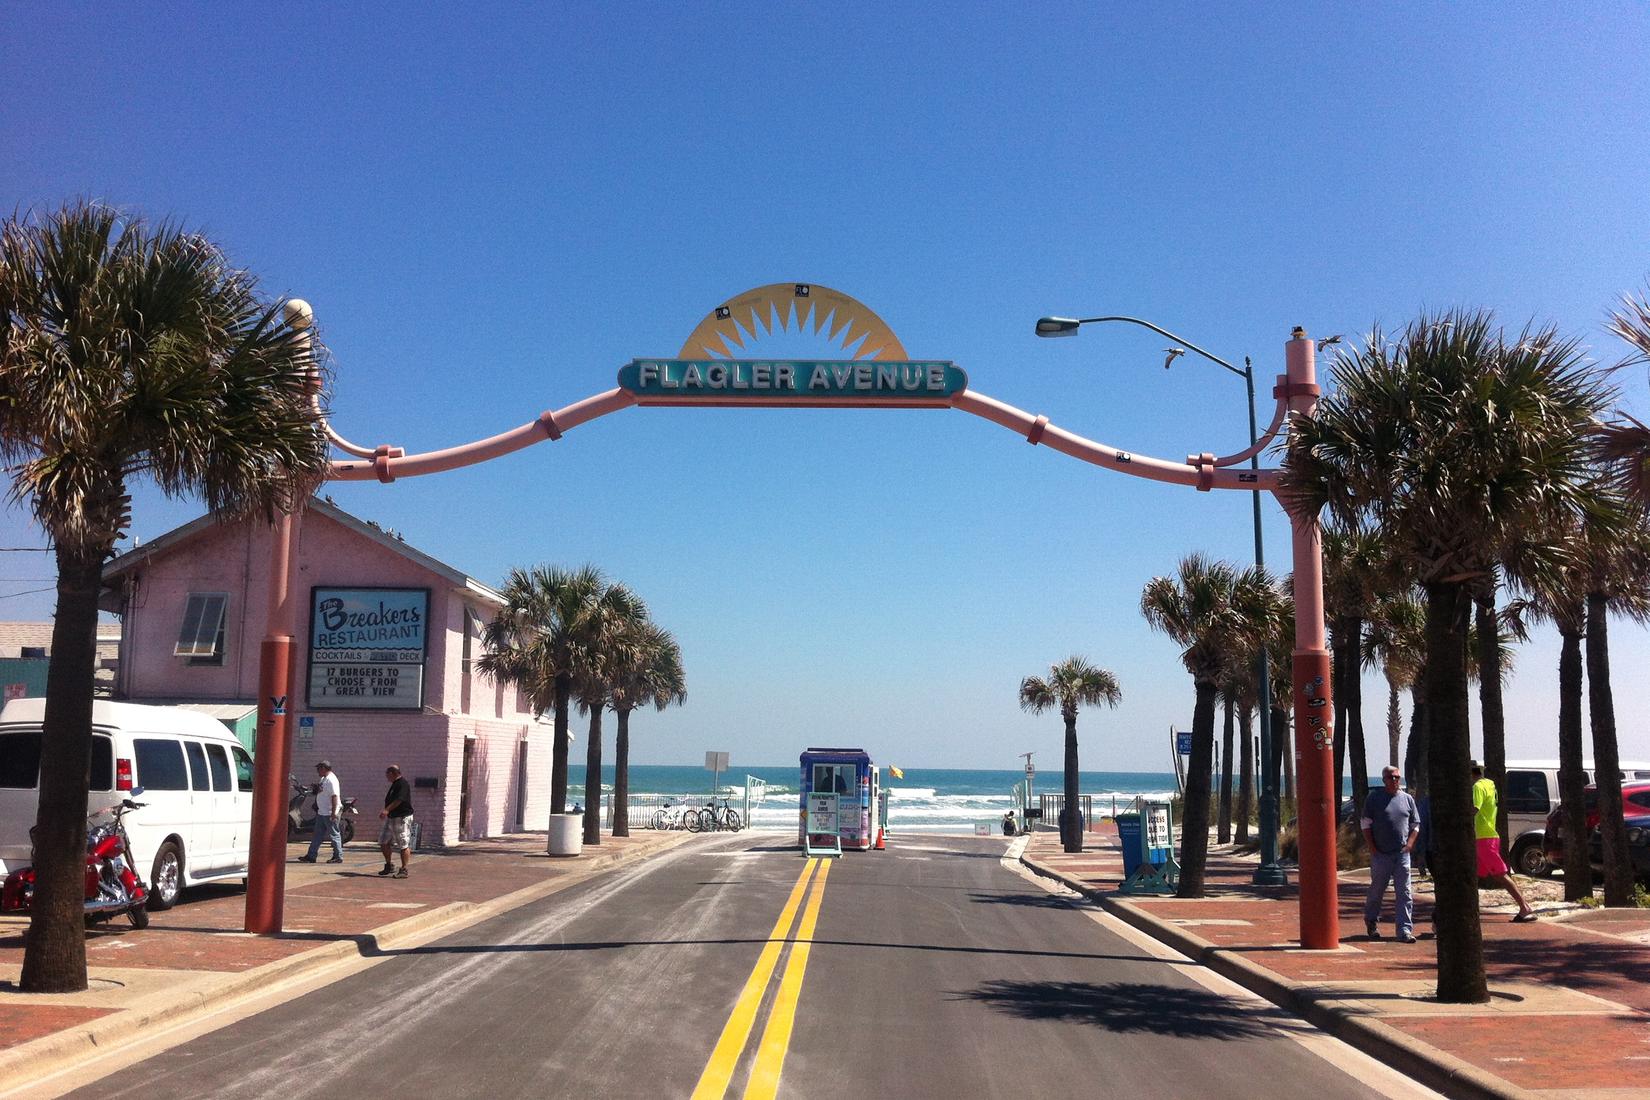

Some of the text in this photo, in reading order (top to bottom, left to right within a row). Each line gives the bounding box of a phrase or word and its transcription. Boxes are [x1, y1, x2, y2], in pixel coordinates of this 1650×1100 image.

[639, 362, 946, 392] FLAGLER AVENUE
[322, 600, 338, 609] The
[320, 598, 421, 631] Breakers
[318, 624, 420, 647] RESTAURANT
[315, 652, 361, 660] COCKTAILS
[400, 652, 420, 661] DECK
[327, 668, 400, 677] 17 BURGERS TO
[328, 677, 398, 687] CHOOSE FROM
[335, 687, 366, 696] GREAT
[372, 687, 396, 696] VIEW
